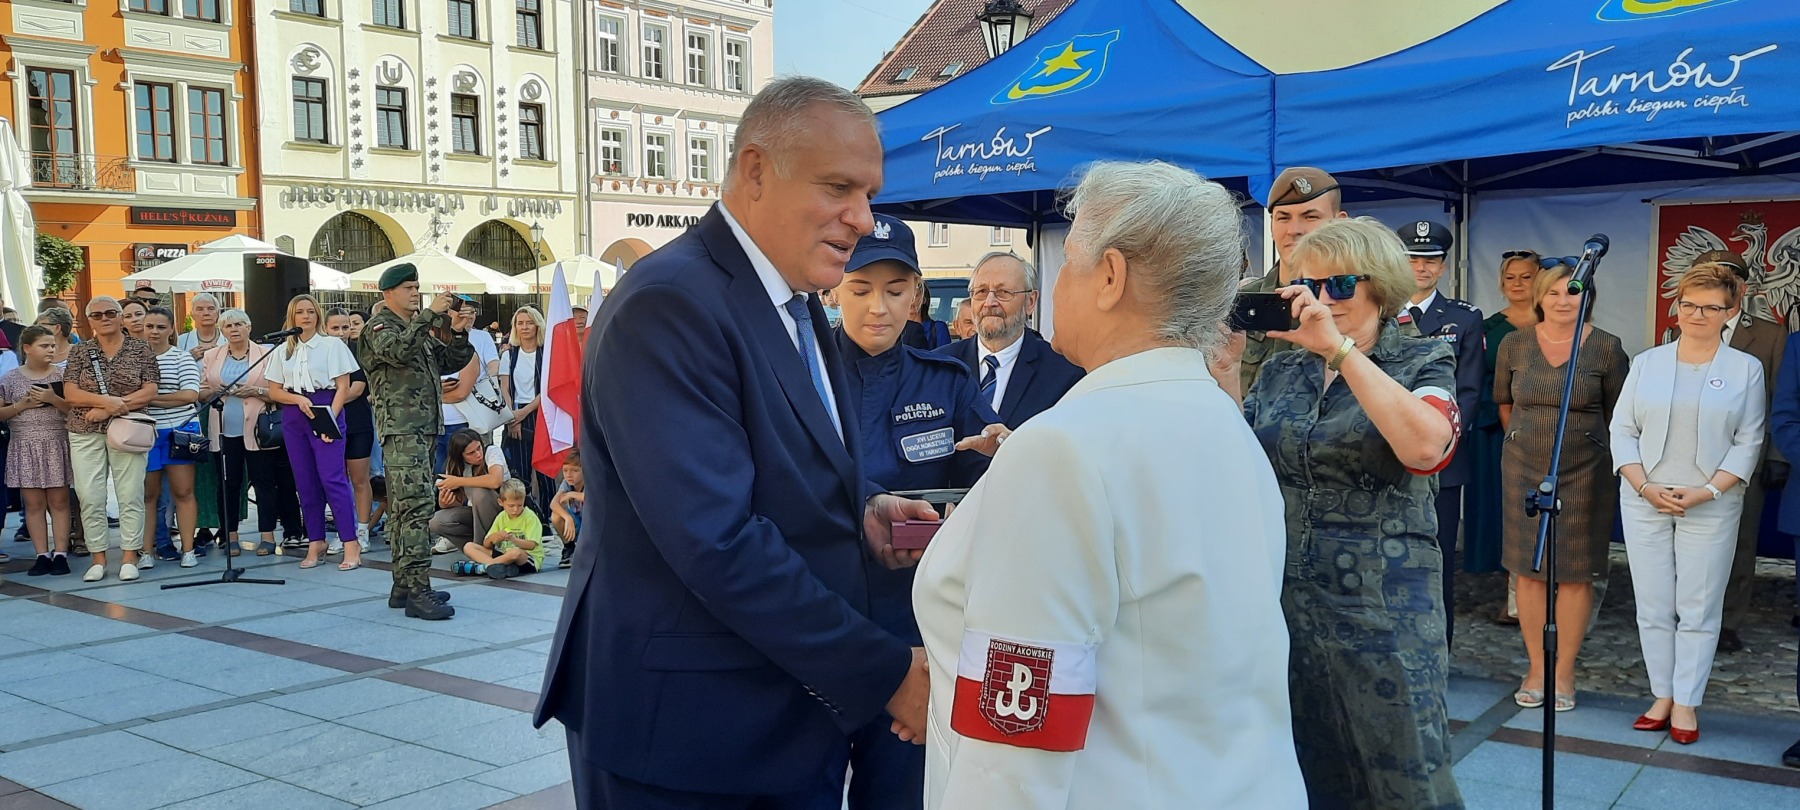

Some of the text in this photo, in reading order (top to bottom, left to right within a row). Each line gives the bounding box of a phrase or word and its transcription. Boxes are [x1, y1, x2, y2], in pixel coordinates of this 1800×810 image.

[1546, 45, 1778, 106] Tarnów
[1566, 86, 1749, 128] polski biegun ciepła
[921, 122, 1052, 168] Tarnów
[933, 156, 1037, 184] polski biegun ciepła
[140, 211, 230, 223] HELL'S KUŹNIA
[625, 213, 654, 227] POD
[156, 248, 186, 258] PIZZA
[362, 282, 380, 290] TYSK
[432, 283, 459, 292] TYSKIE
[904, 402, 933, 413] KLASA
[895, 408, 945, 422] POLICYJNA
[990, 641, 1053, 660] RODZINY AKOWSKIE
